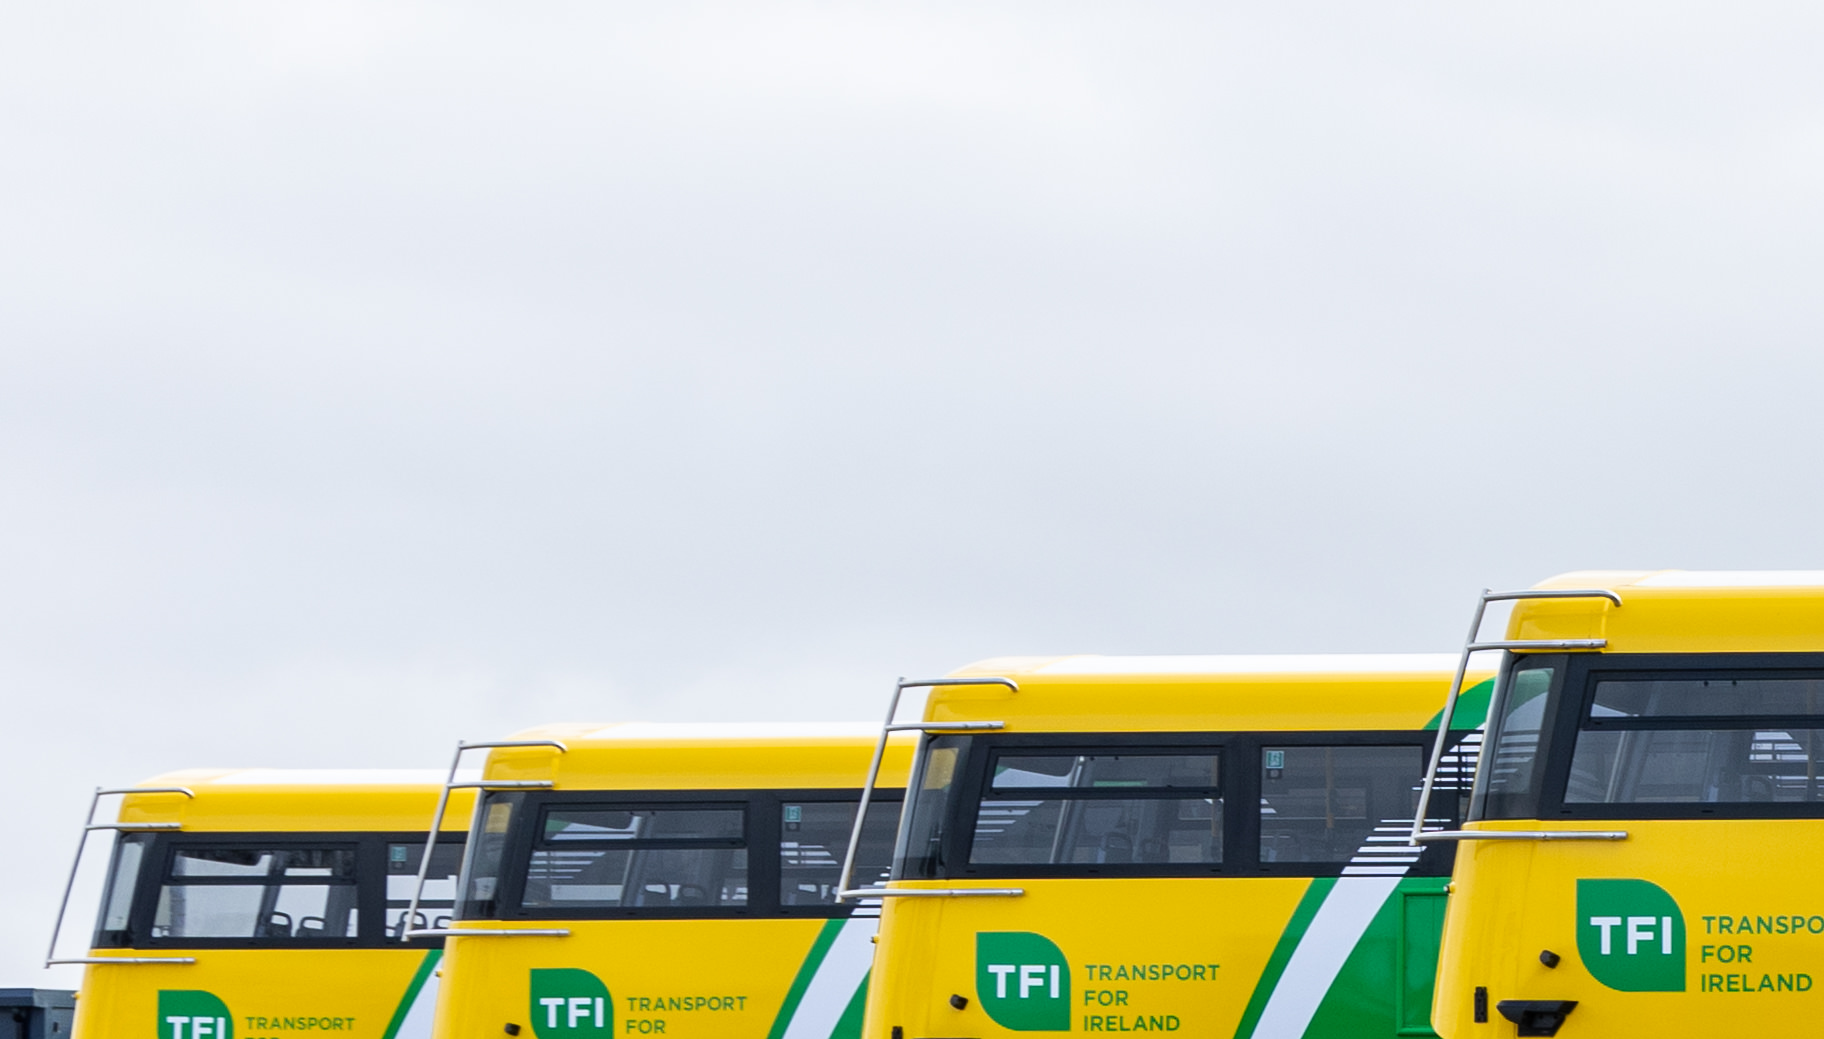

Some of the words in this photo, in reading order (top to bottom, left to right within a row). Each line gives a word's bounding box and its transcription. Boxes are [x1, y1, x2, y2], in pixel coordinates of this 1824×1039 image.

[1590, 917, 1671, 954] TFI
[1702, 945, 1752, 963] FOR
[1085, 965, 1220, 980] TRANSPORT
[988, 965, 1059, 998] TFI
[1702, 974, 1812, 992] IRELAND
[627, 996, 747, 1011] TRANSPORT
[1085, 990, 1128, 1006] FOR
[540, 998, 603, 1027] TFI
[246, 1017, 355, 1030] TRANSPORT
[627, 1020, 665, 1034] FOR
[1085, 1015, 1180, 1031] IRELAND
